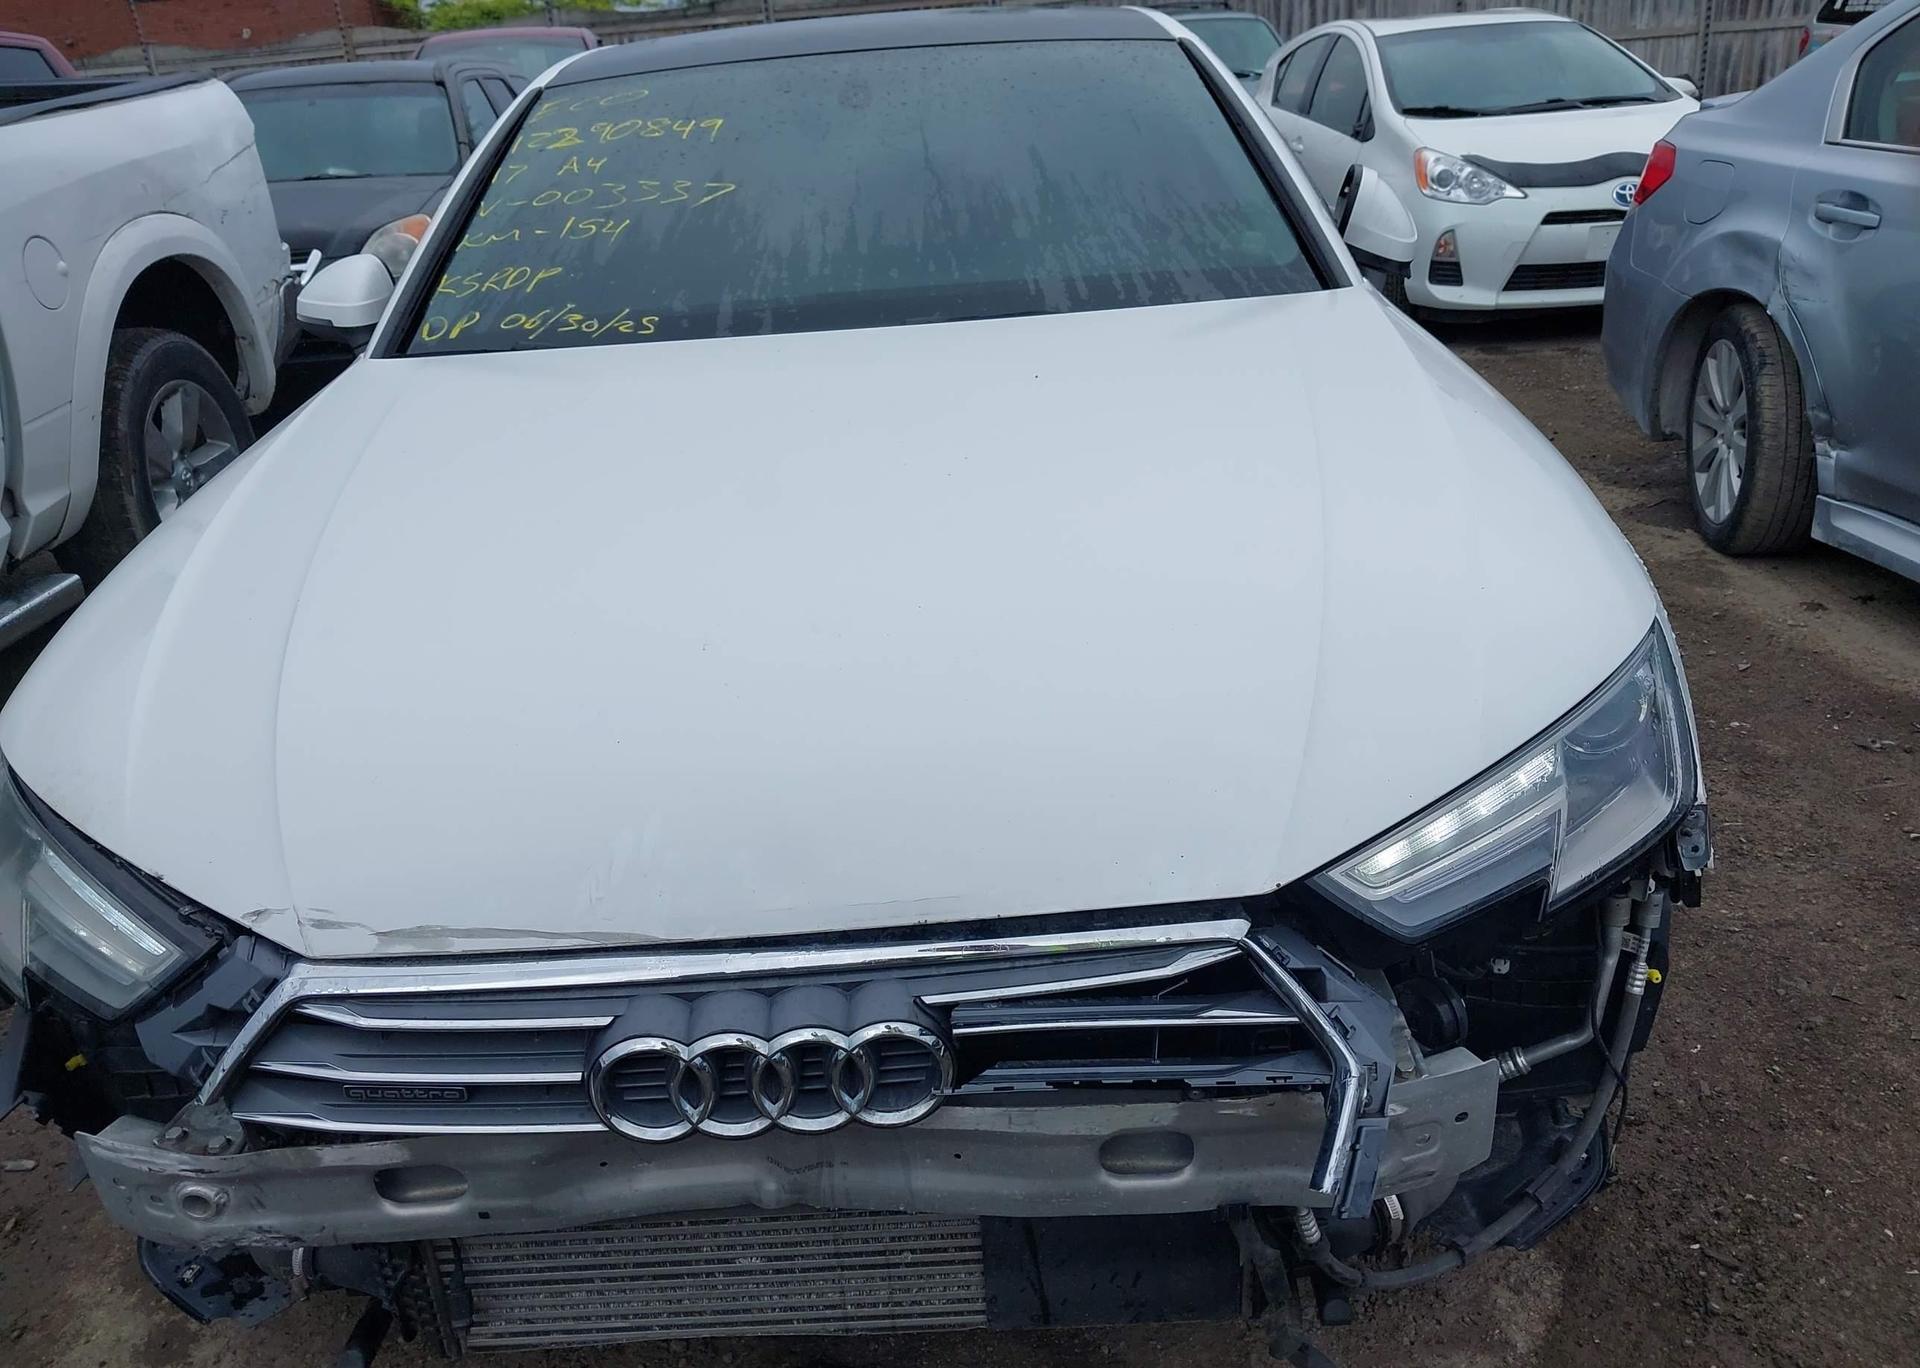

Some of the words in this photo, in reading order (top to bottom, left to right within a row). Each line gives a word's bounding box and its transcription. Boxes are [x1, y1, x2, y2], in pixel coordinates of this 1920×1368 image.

[556, 156, 608, 176] A4
[500, 303, 660, 340] 06/30/25
[350, 1088, 460, 1100] quattro
